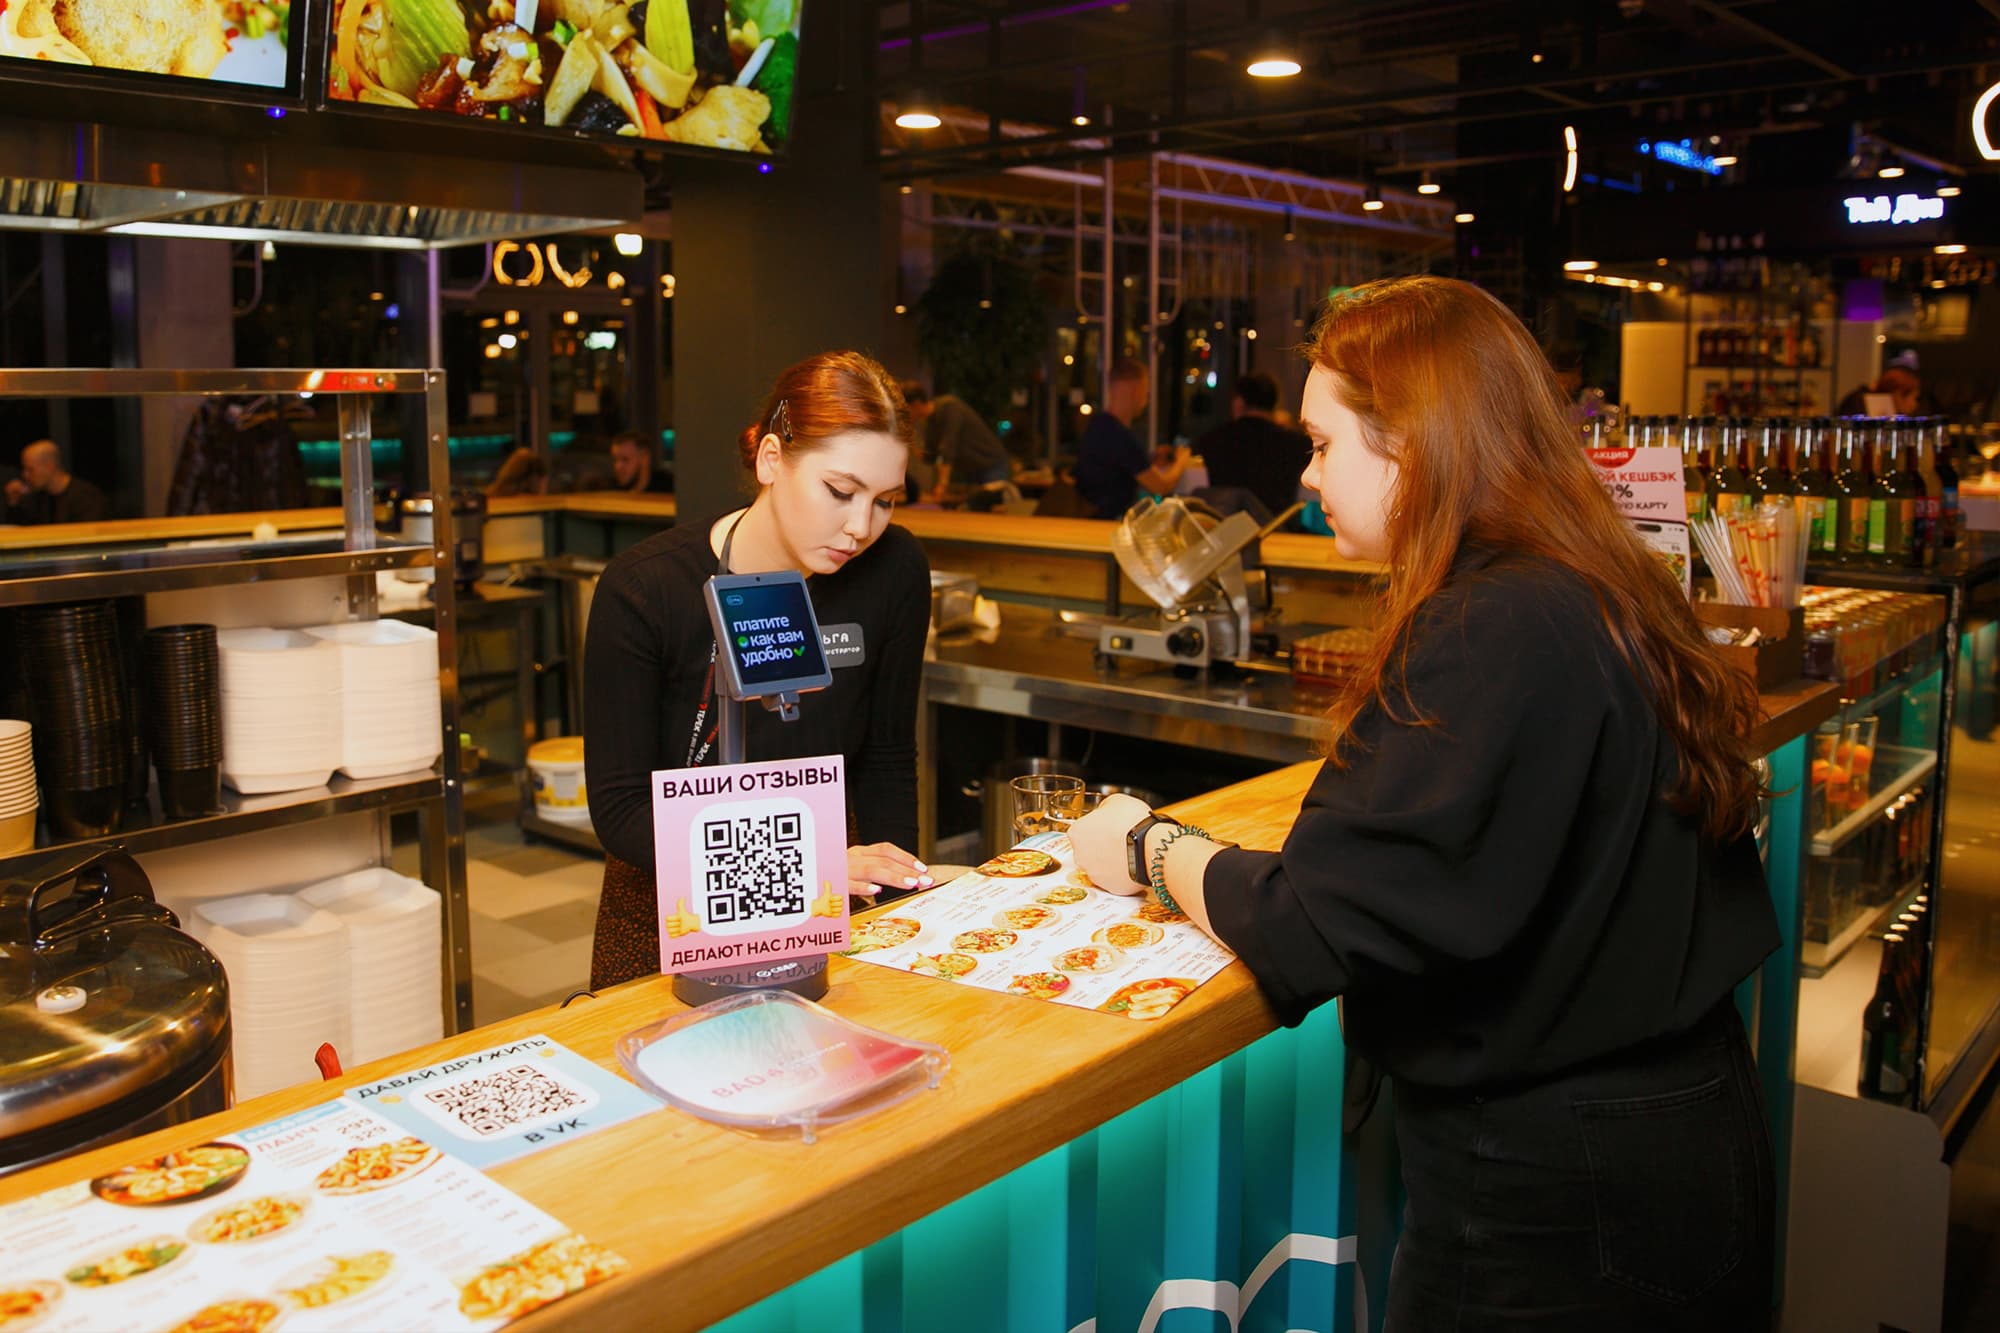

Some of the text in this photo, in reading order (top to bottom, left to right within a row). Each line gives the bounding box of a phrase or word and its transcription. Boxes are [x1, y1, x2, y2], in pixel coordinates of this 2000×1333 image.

[1619, 471, 1677, 482] КЕШБЭК
[1603, 483, 1633, 498] 0%
[1635, 501, 1668, 510] КАРТУ
[733, 615, 790, 633] платите
[750, 630, 804, 648] как вам
[822, 632, 849, 645] ЬГА
[740, 645, 793, 668] удобно
[663, 766, 838, 799] ВАШИ ОТЗЫВЫ
[671, 931, 843, 967] ДЕЛАЮТ НАС ЛУЧШЕ
[358, 1040, 547, 1099] ДАВАЙ ДРУЖИТЬ
[256, 1126, 320, 1153] ЛАНЧ
[524, 1117, 589, 1143] В VK
